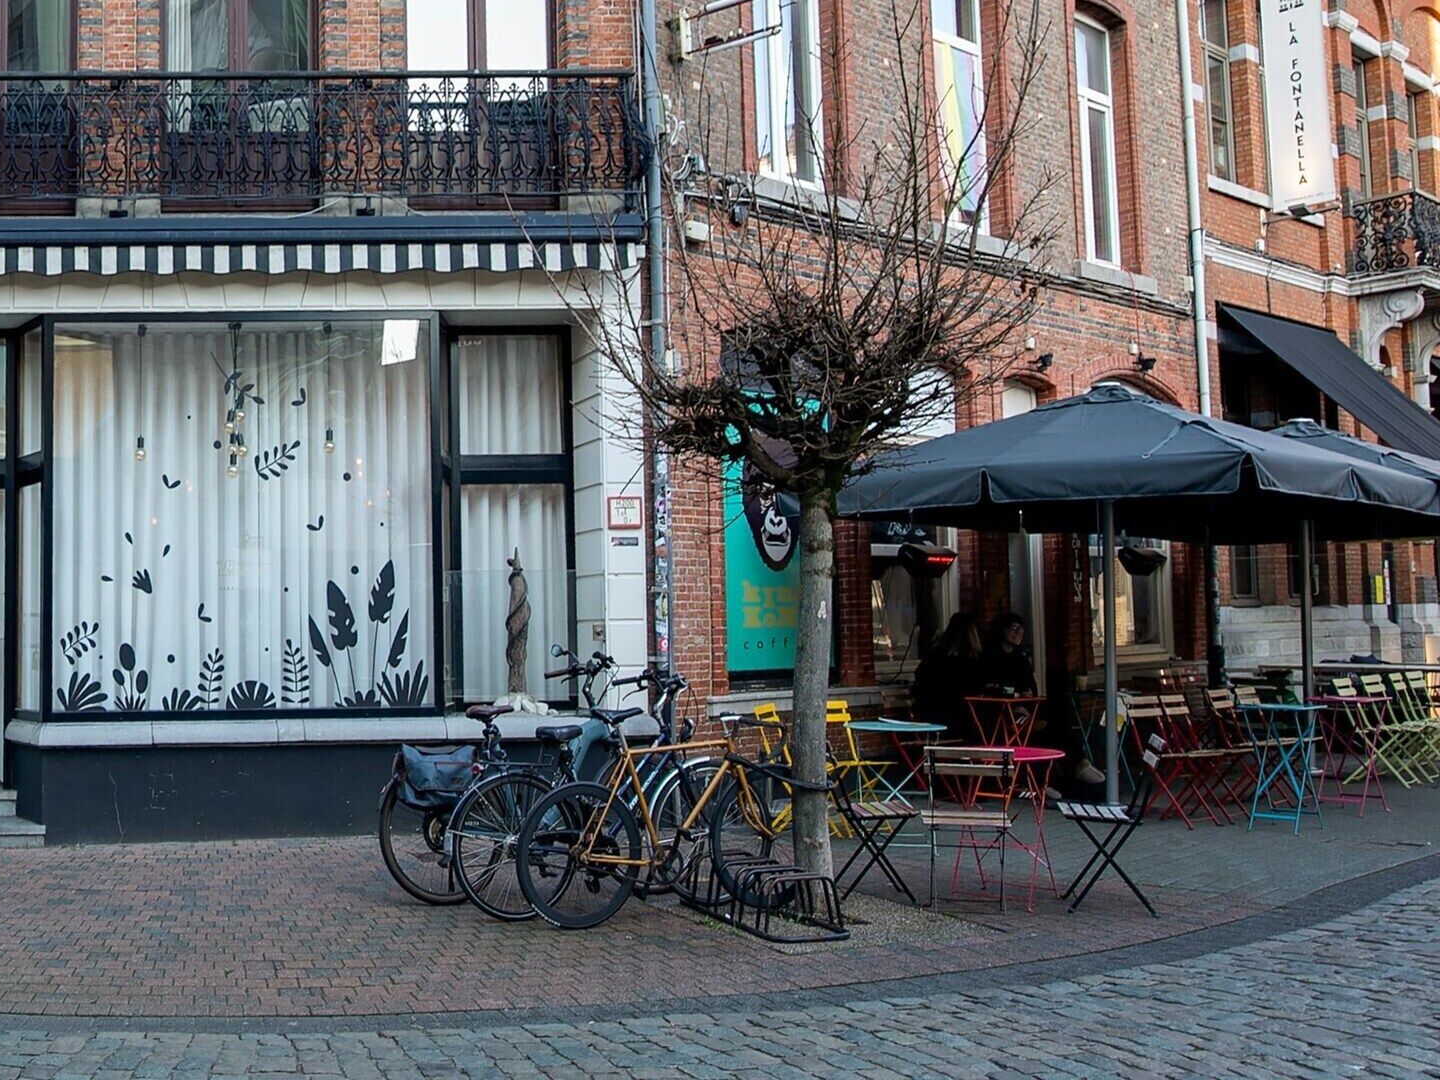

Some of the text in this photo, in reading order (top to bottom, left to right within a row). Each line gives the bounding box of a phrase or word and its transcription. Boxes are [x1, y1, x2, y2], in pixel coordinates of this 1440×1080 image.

[1288, 22, 1308, 185] LA FONTANELLA
[741, 579, 800, 608] kin
[742, 606, 796, 629] KoN
[743, 636, 789, 650] coff
